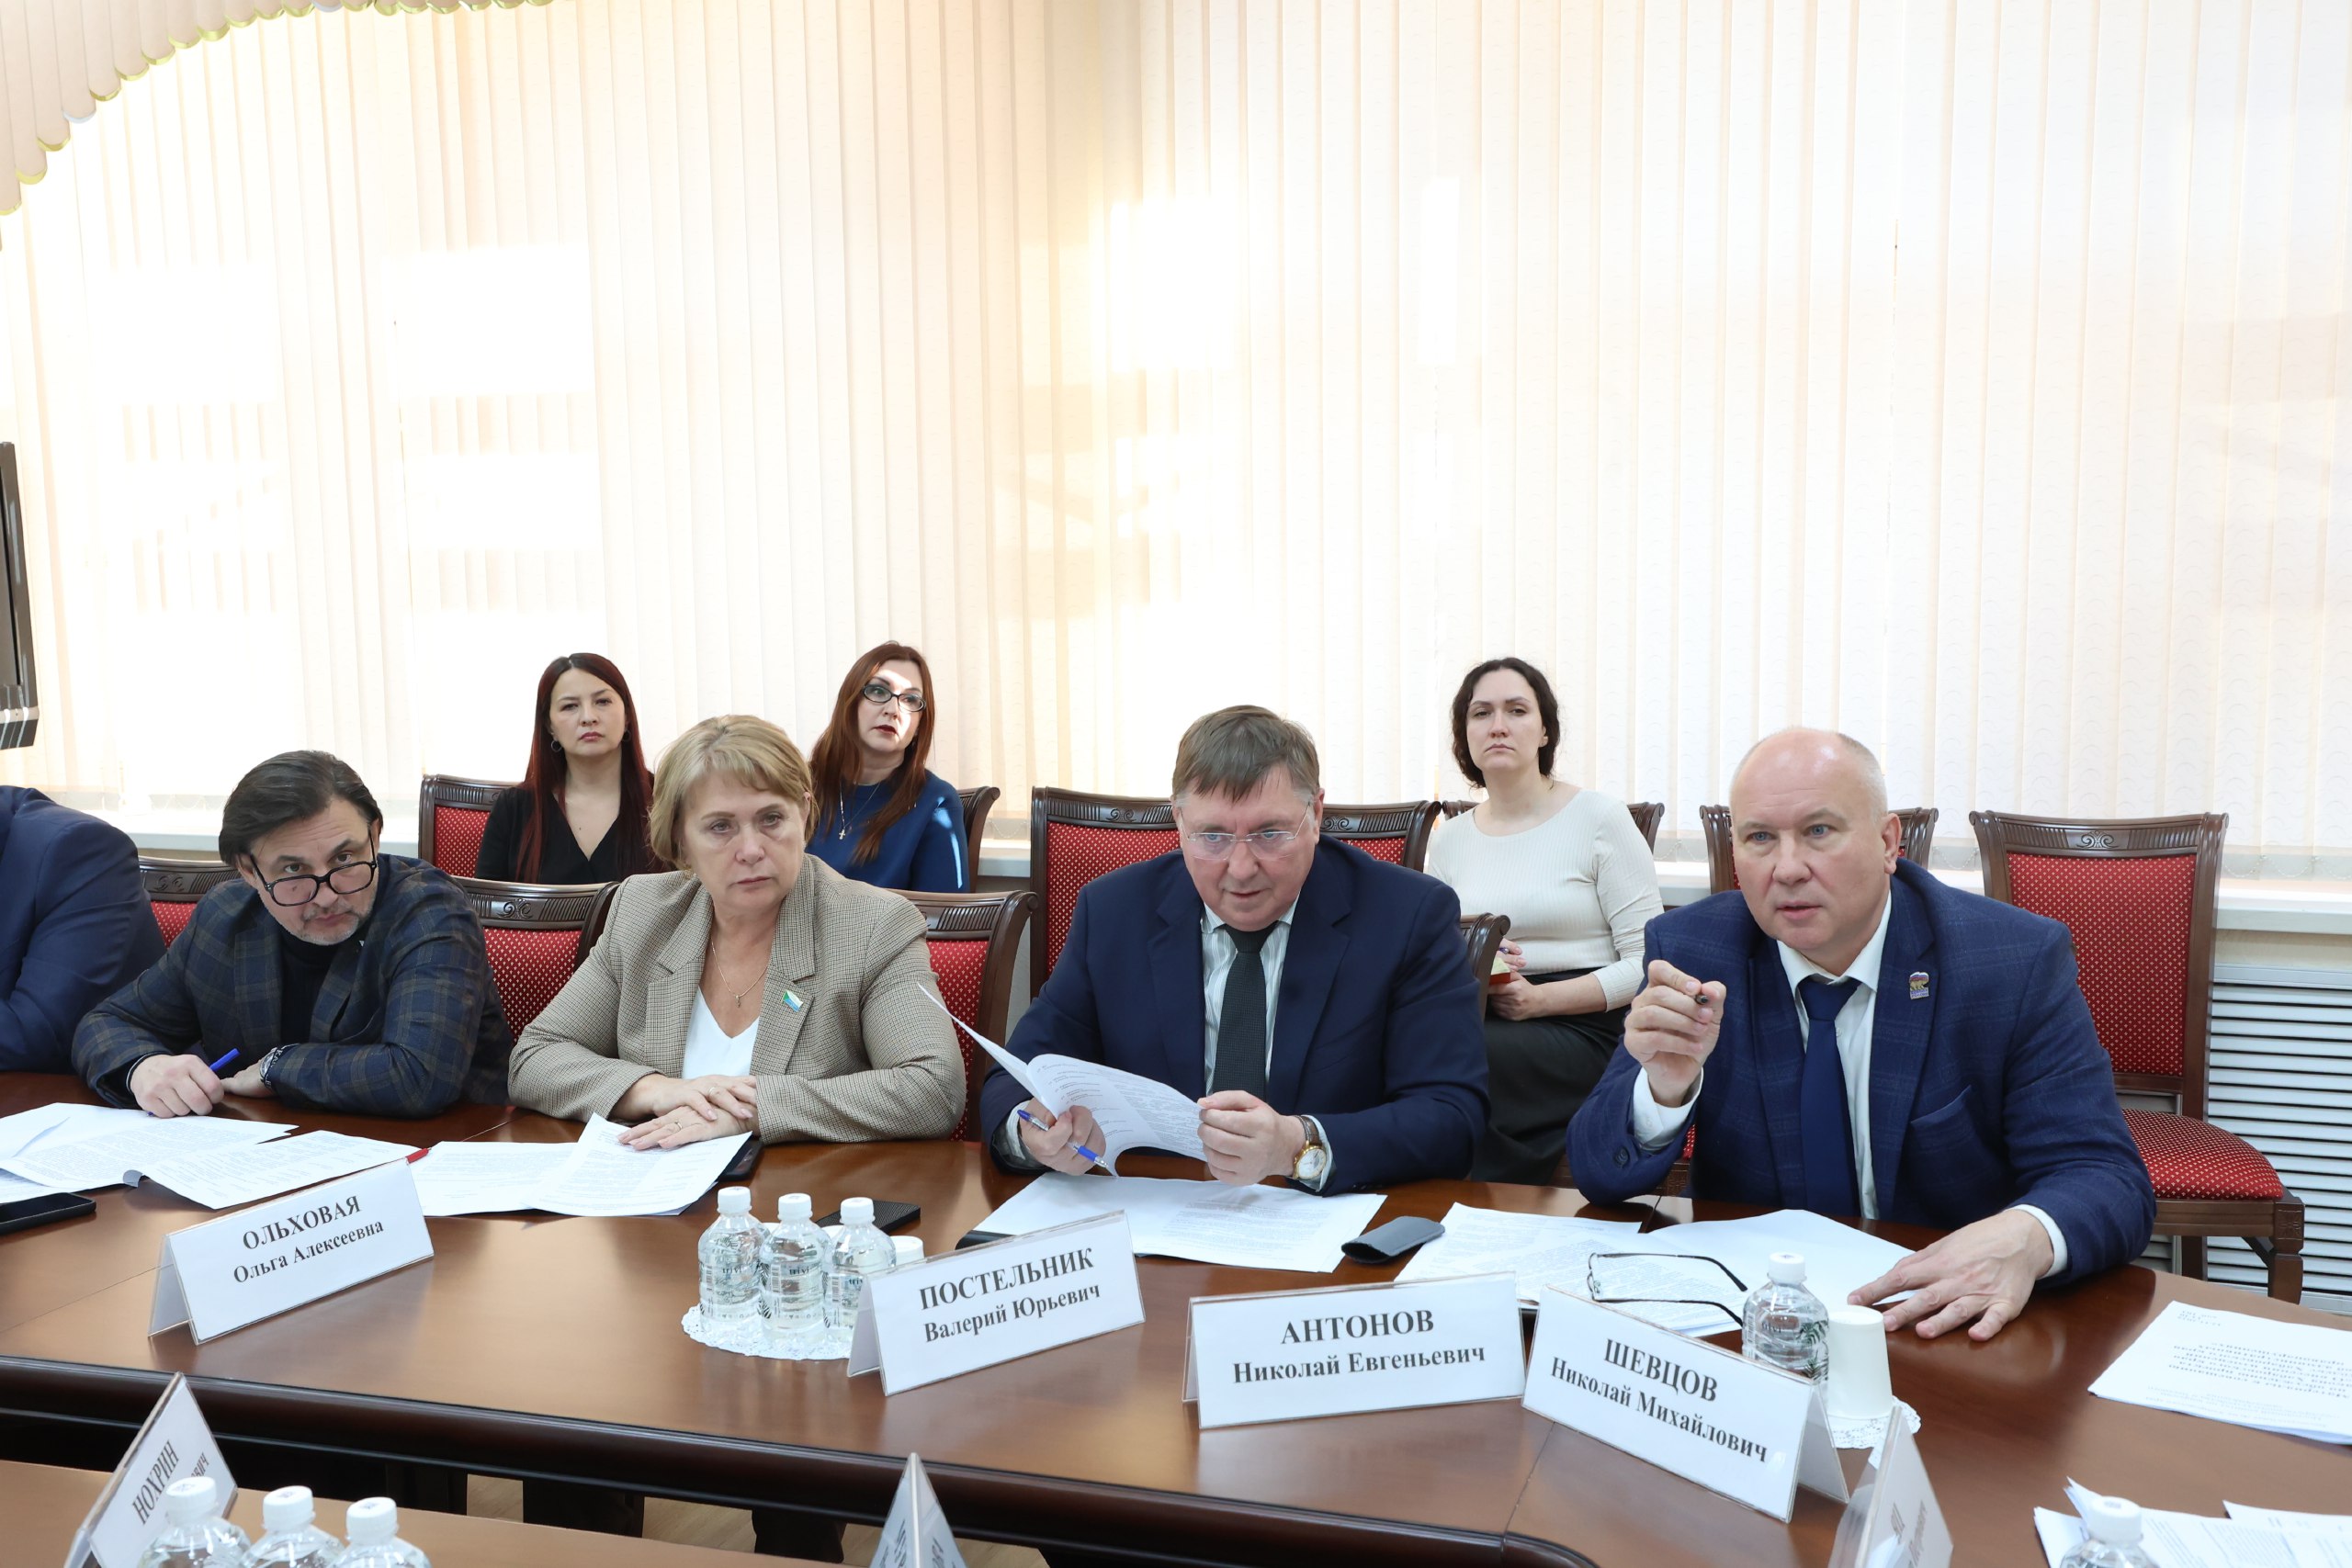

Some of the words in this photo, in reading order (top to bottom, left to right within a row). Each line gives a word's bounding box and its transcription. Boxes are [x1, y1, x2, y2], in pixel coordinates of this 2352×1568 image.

[233, 1255, 288, 1283] Ольга
[293, 1221, 384, 1263] Алексеевна
[243, 1196, 362, 1249] ОЛЬХОВАЯ
[919, 1247, 1094, 1311] ПОСТЕЛЬНИК
[923, 1303, 1008, 1343] Валерий
[1012, 1284, 1101, 1319] Юрьевич
[1280, 1309, 1434, 1345] АНТОНОВ
[1233, 1354, 1340, 1383] Николай
[1347, 1347, 1486, 1373] Евгеньевич
[1603, 1338, 1719, 1403] ШЕВЦОВ
[1550, 1356, 1633, 1407] Николай
[1636, 1390, 1769, 1462] Михайлович
[131, 1439, 179, 1525] НОХРИН
